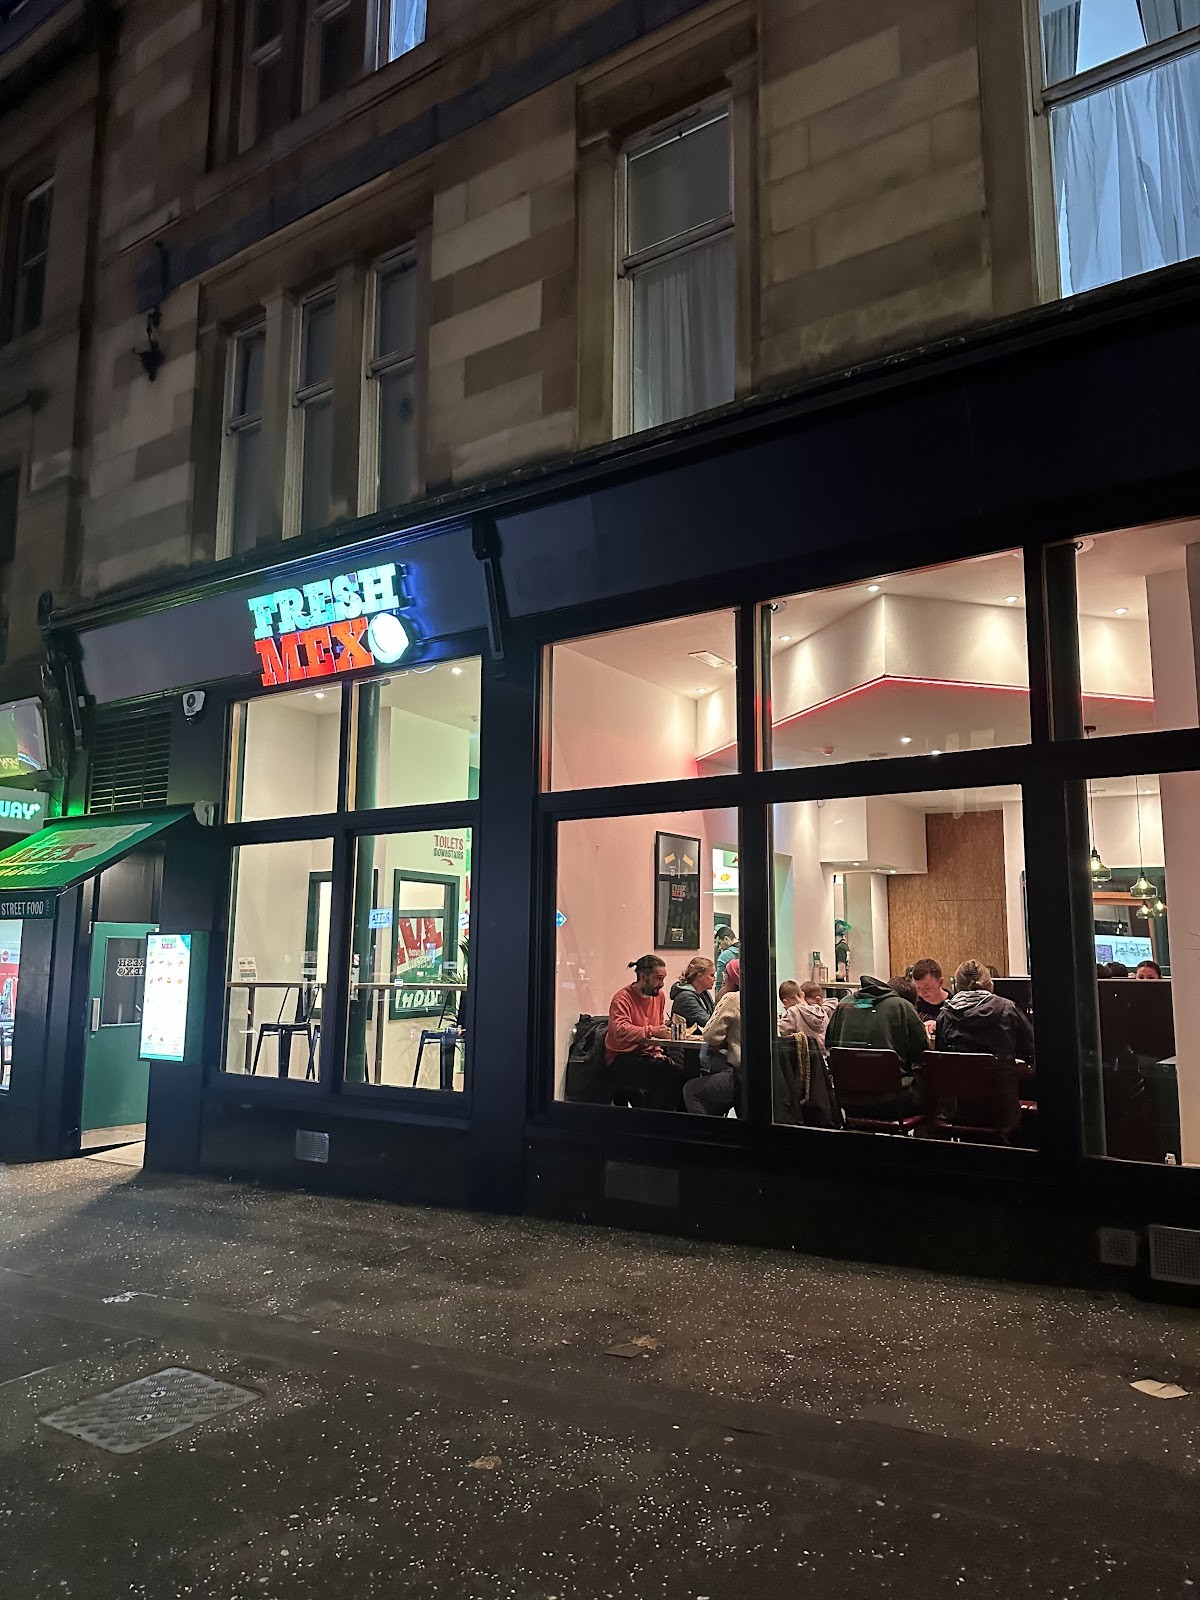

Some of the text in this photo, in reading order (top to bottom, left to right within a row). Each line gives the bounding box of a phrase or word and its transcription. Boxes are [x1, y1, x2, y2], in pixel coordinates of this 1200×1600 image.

[248, 562, 397, 639] FRESH
[434, 834, 464, 850] TOILETS
[1, 901, 44, 916] STREET FOOD
